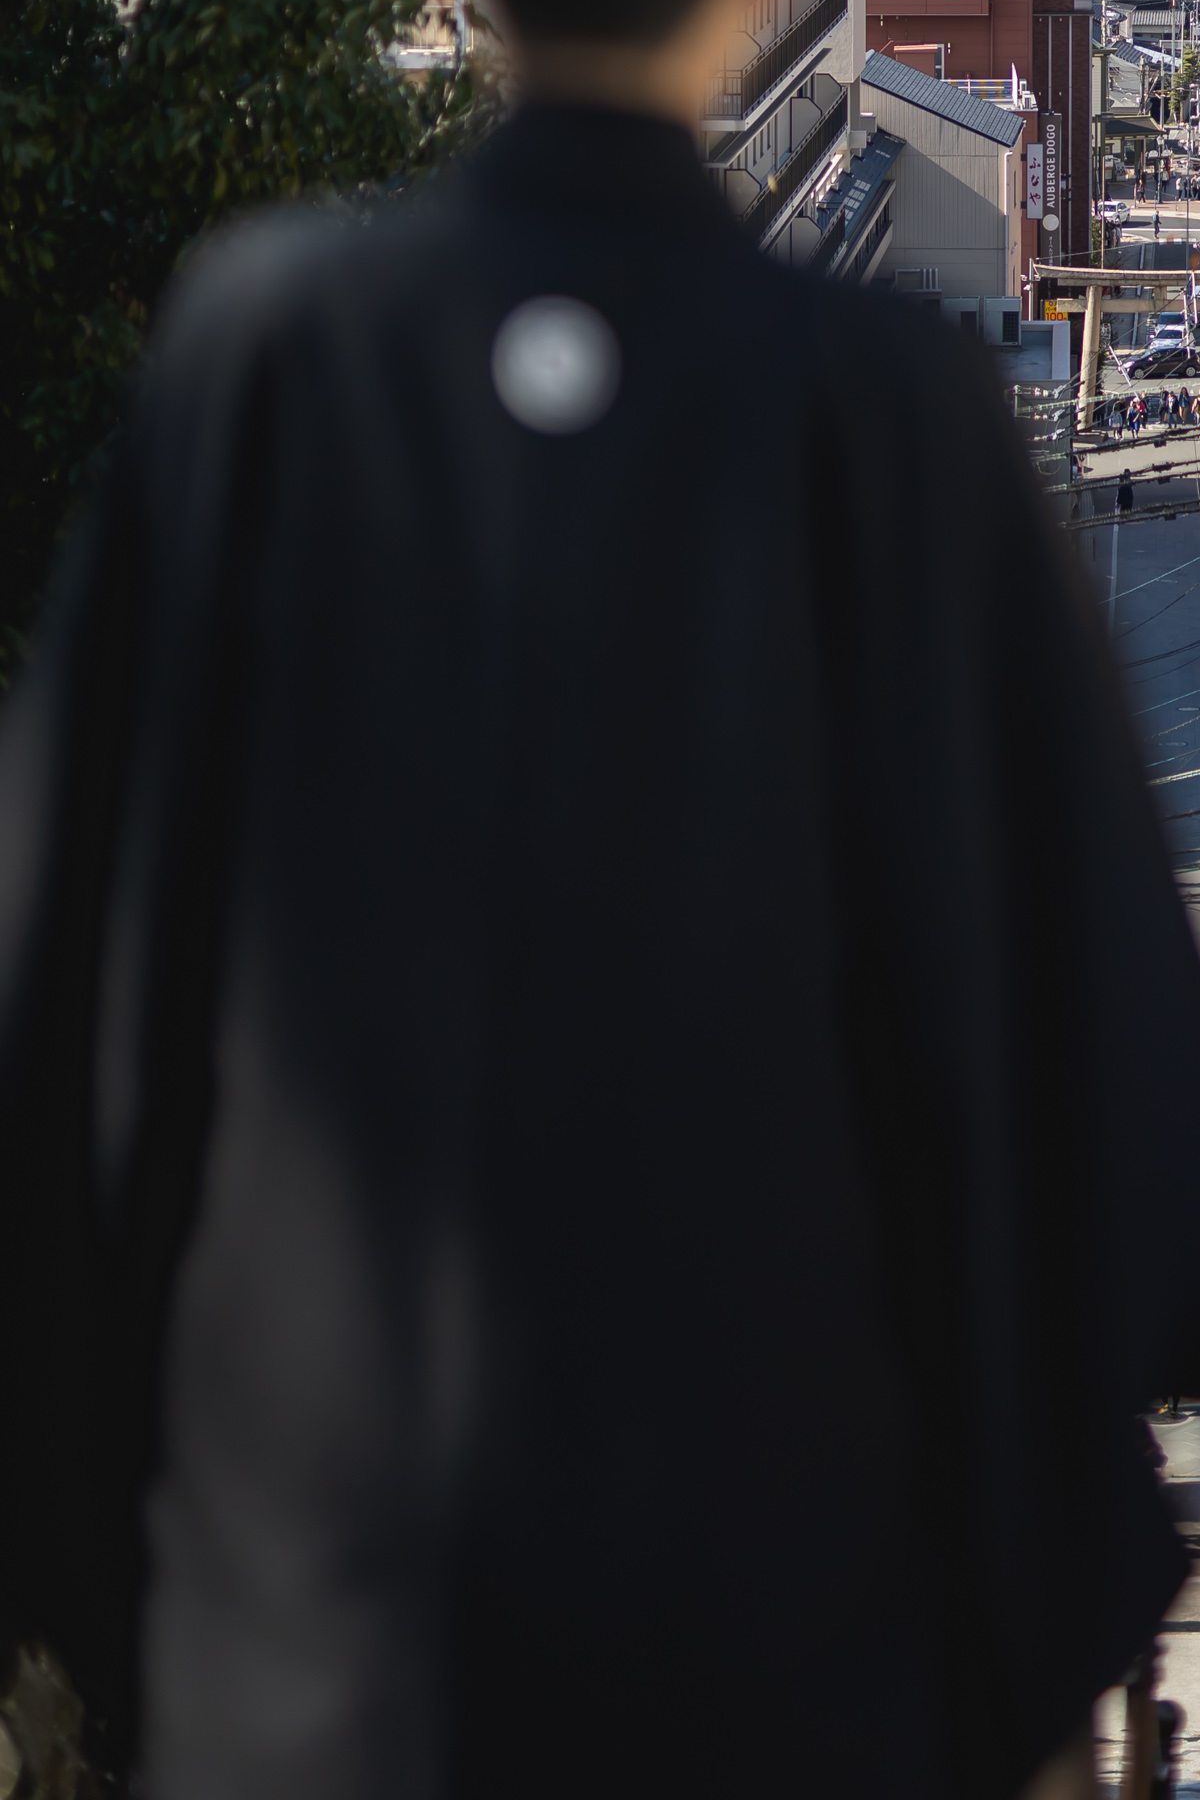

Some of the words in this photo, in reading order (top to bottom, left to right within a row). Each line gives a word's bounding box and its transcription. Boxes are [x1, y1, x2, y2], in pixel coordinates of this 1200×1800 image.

[1046, 124, 1056, 155] DOGO
[1029, 157, 1041, 206] ふなや
[1046, 157, 1056, 208] AUBERGE
